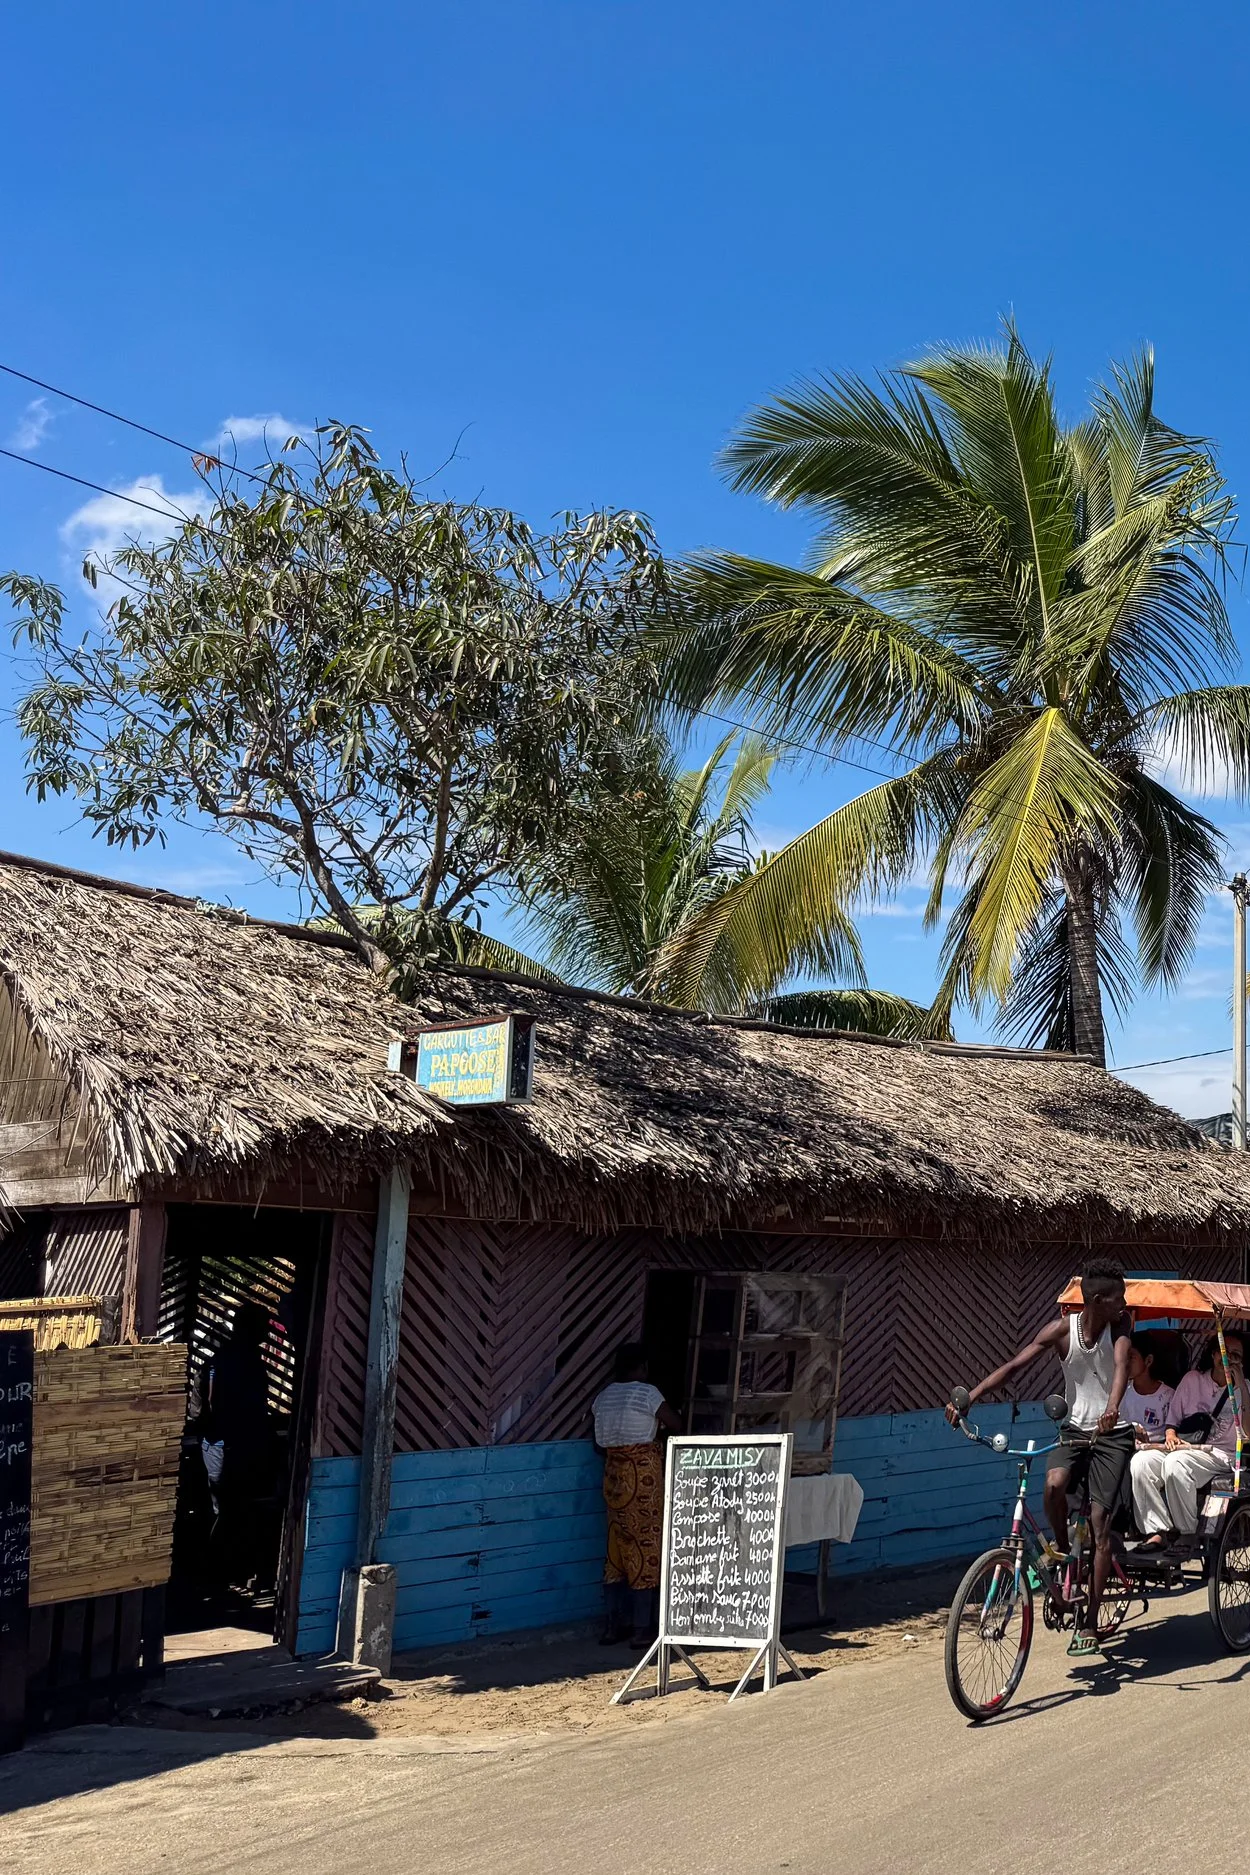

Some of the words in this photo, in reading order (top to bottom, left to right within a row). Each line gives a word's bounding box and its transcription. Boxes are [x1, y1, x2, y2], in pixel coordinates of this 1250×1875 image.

[486, 1024, 506, 1046] BAR
[674, 1470, 709, 1496] Soupe
[673, 1492, 709, 1516] Soupe
